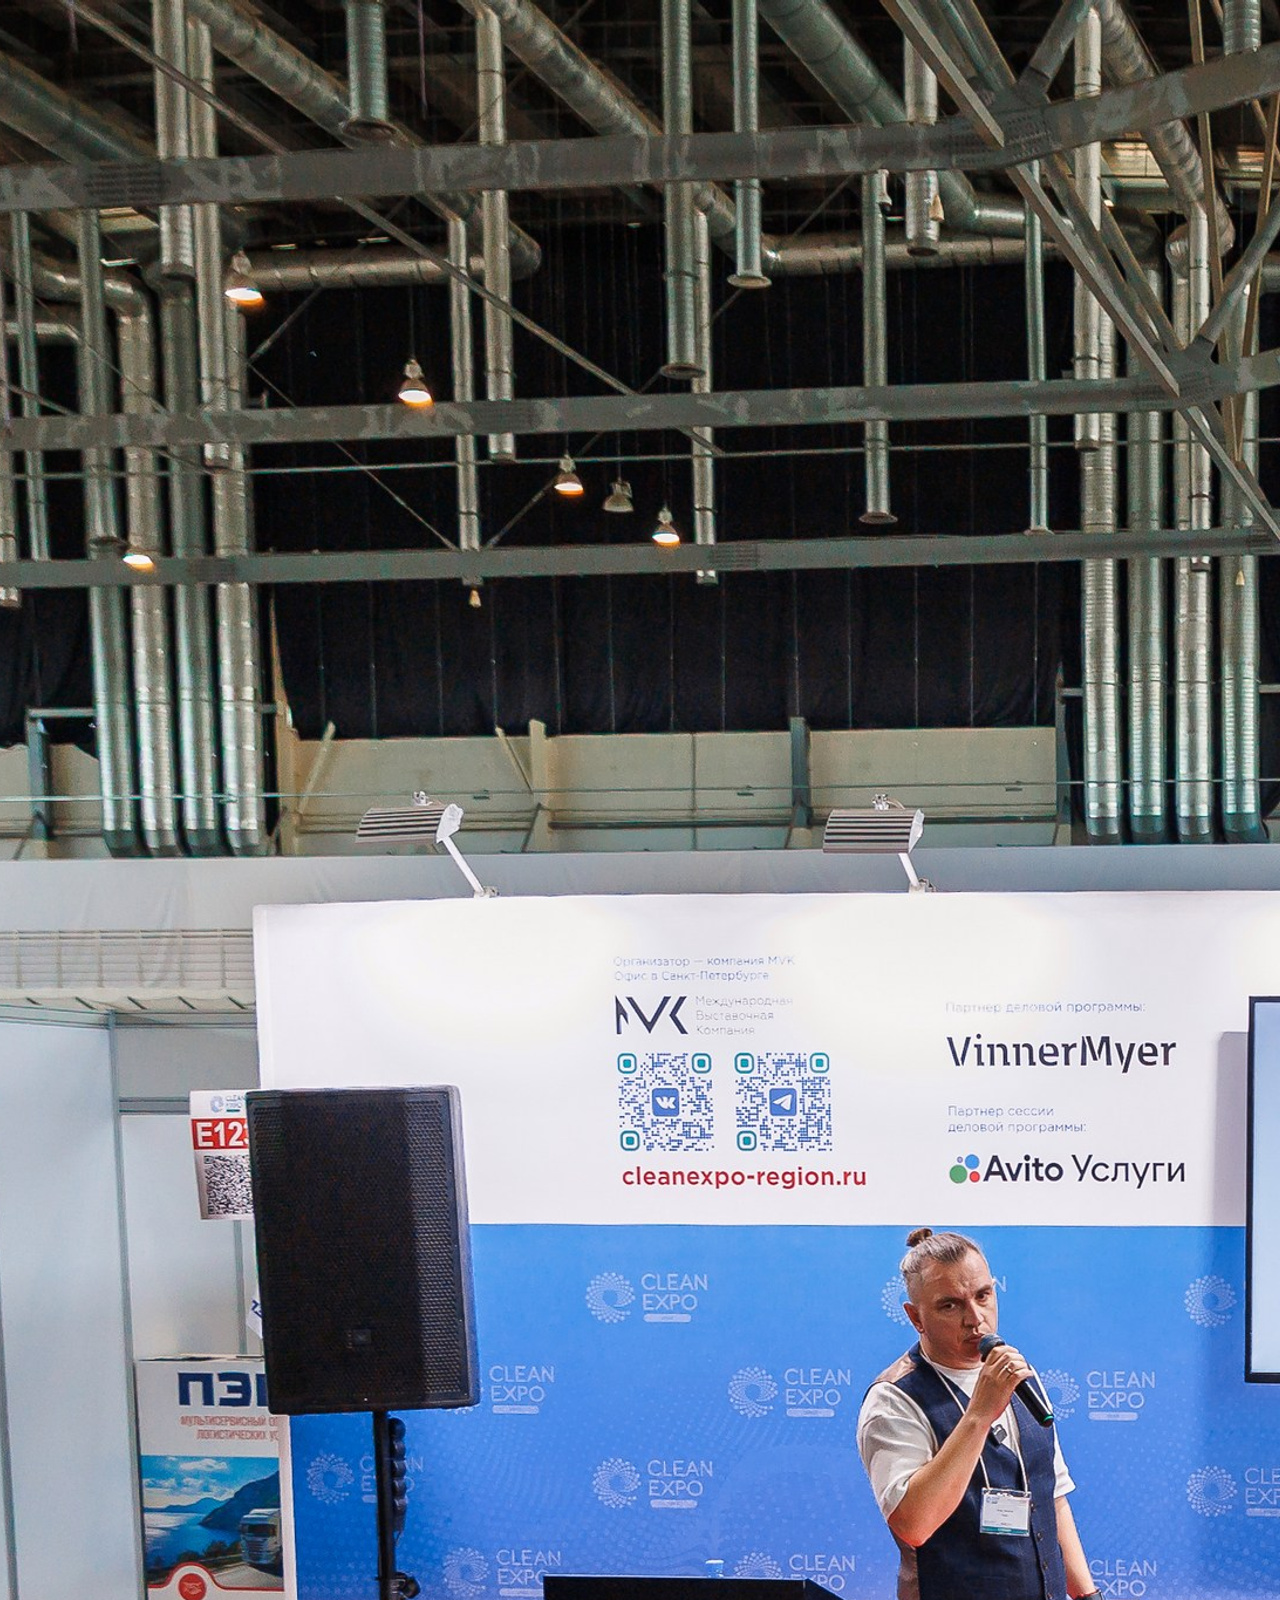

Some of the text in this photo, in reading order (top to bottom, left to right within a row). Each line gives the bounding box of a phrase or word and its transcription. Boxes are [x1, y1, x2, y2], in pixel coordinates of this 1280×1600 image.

[613, 956, 691, 968] Организатор
[707, 957, 764, 967] компания
[614, 970, 648, 982] Офис
[661, 970, 770, 982] Санкт-Петербурге
[696, 1010, 774, 1021] Выставочная
[1006, 1000, 1062, 1013] деловой
[1067, 1002, 1146, 1014] программы:
[697, 1025, 756, 1036] Компания
[947, 1033, 1177, 1074] VinnerMyer
[948, 1105, 1054, 1119] Партнер сессии
[947, 1121, 1087, 1134] деловой программы:
[622, 1166, 867, 1189] cleanexpo-region.ru
[983, 1154, 1186, 1189] Avito Услуги
[641, 1273, 708, 1291] CLEAN
[642, 1294, 698, 1311] EXPO
[489, 1366, 554, 1384] CLEAN
[784, 1368, 851, 1386] CLEAN
[1086, 1371, 1156, 1389] CLEAN
[490, 1385, 545, 1403] EXPO
[785, 1388, 841, 1407] EXPO
[1087, 1391, 1145, 1410] EXPO
[647, 1460, 713, 1477] CLEAN
[648, 1480, 703, 1496] EXPO
[496, 1549, 561, 1566] CLEAN
[789, 1553, 856, 1572] CLEAN
[1089, 1559, 1157, 1576] CLEAN
